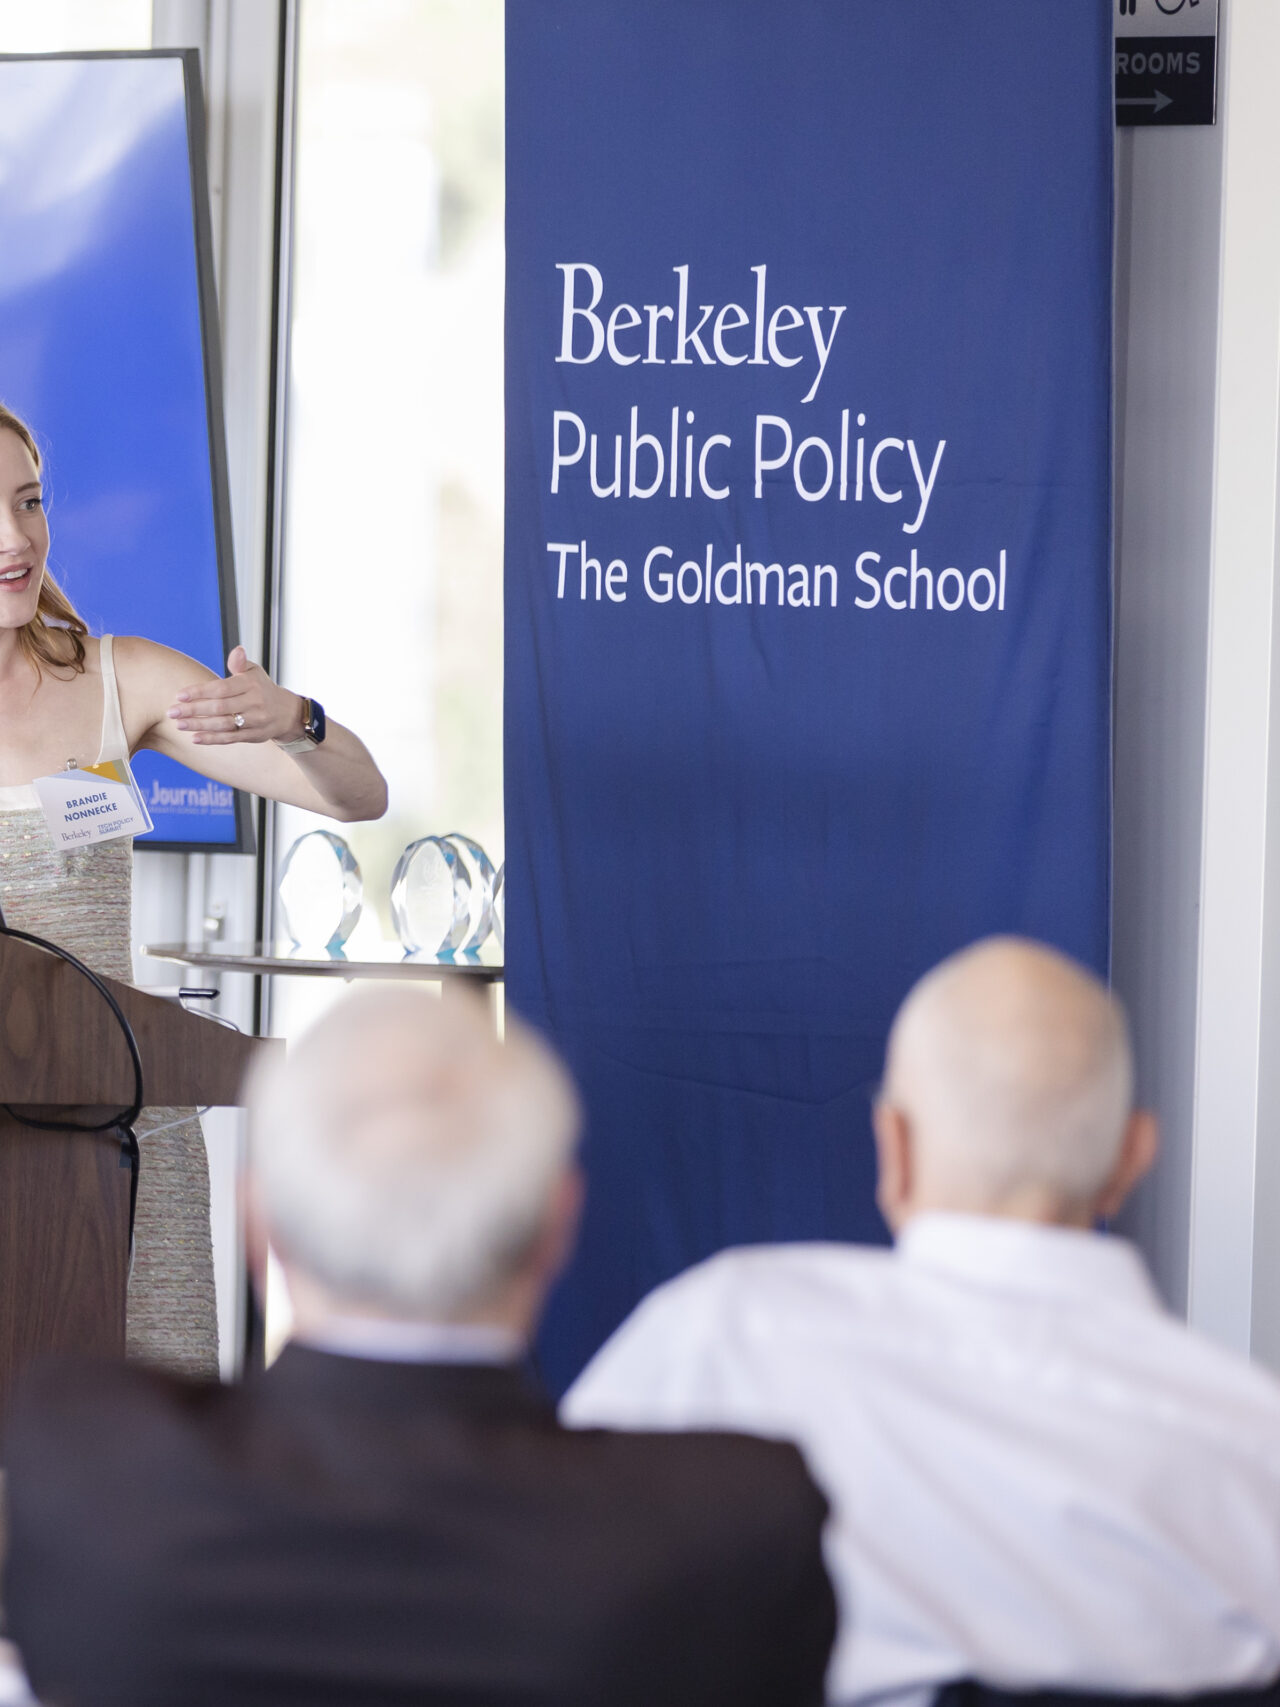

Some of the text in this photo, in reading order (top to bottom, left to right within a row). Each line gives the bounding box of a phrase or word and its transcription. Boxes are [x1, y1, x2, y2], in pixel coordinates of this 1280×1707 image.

[554, 262, 847, 404] Berkeley
[550, 405, 947, 534] Public Policy
[546, 540, 1008, 612] The Goldman School
[63, 802, 118, 822] NONNECKE
[65, 791, 108, 809] BRANDIE
